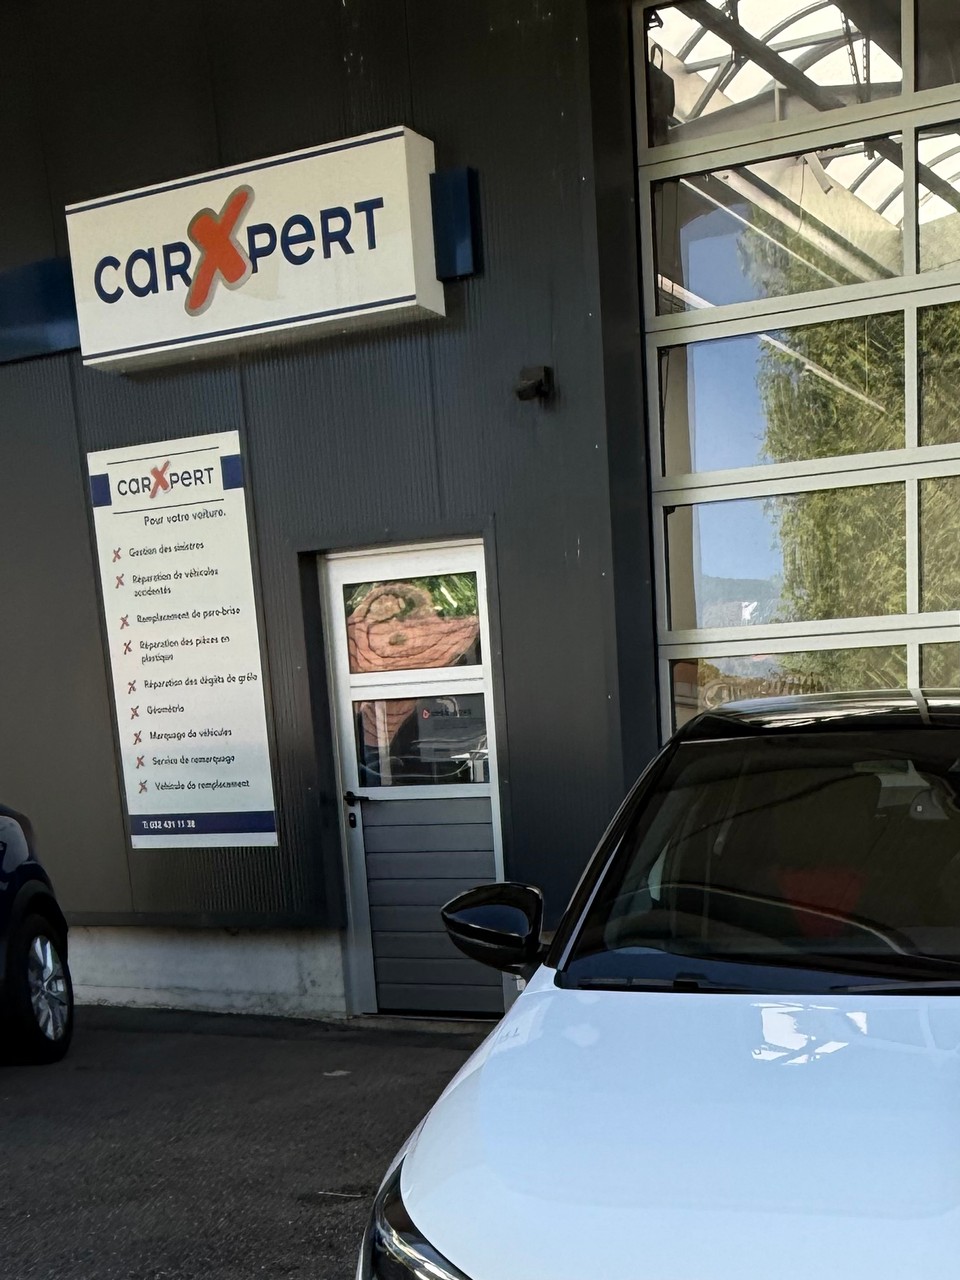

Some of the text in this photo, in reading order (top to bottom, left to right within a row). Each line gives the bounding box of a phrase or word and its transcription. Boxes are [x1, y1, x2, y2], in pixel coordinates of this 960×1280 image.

[144, 515, 163, 526] Pour
[166, 513, 189, 523] votre
[129, 546, 157, 557] Gestion
[159, 544, 172, 554] des
[174, 570, 182, 580] de
[136, 611, 189, 624] Remplacement
[192, 609, 200, 618] de
[139, 639, 179, 651] Réparation
[181, 637, 193, 646] des
[144, 678, 182, 690] Réparation
[185, 677, 197, 686] des
[226, 674, 235, 683] de
[188, 729, 196, 738] de
[152, 756, 177, 766] Service
[180, 755, 189, 764] de
[187, 780, 196, 790] de
